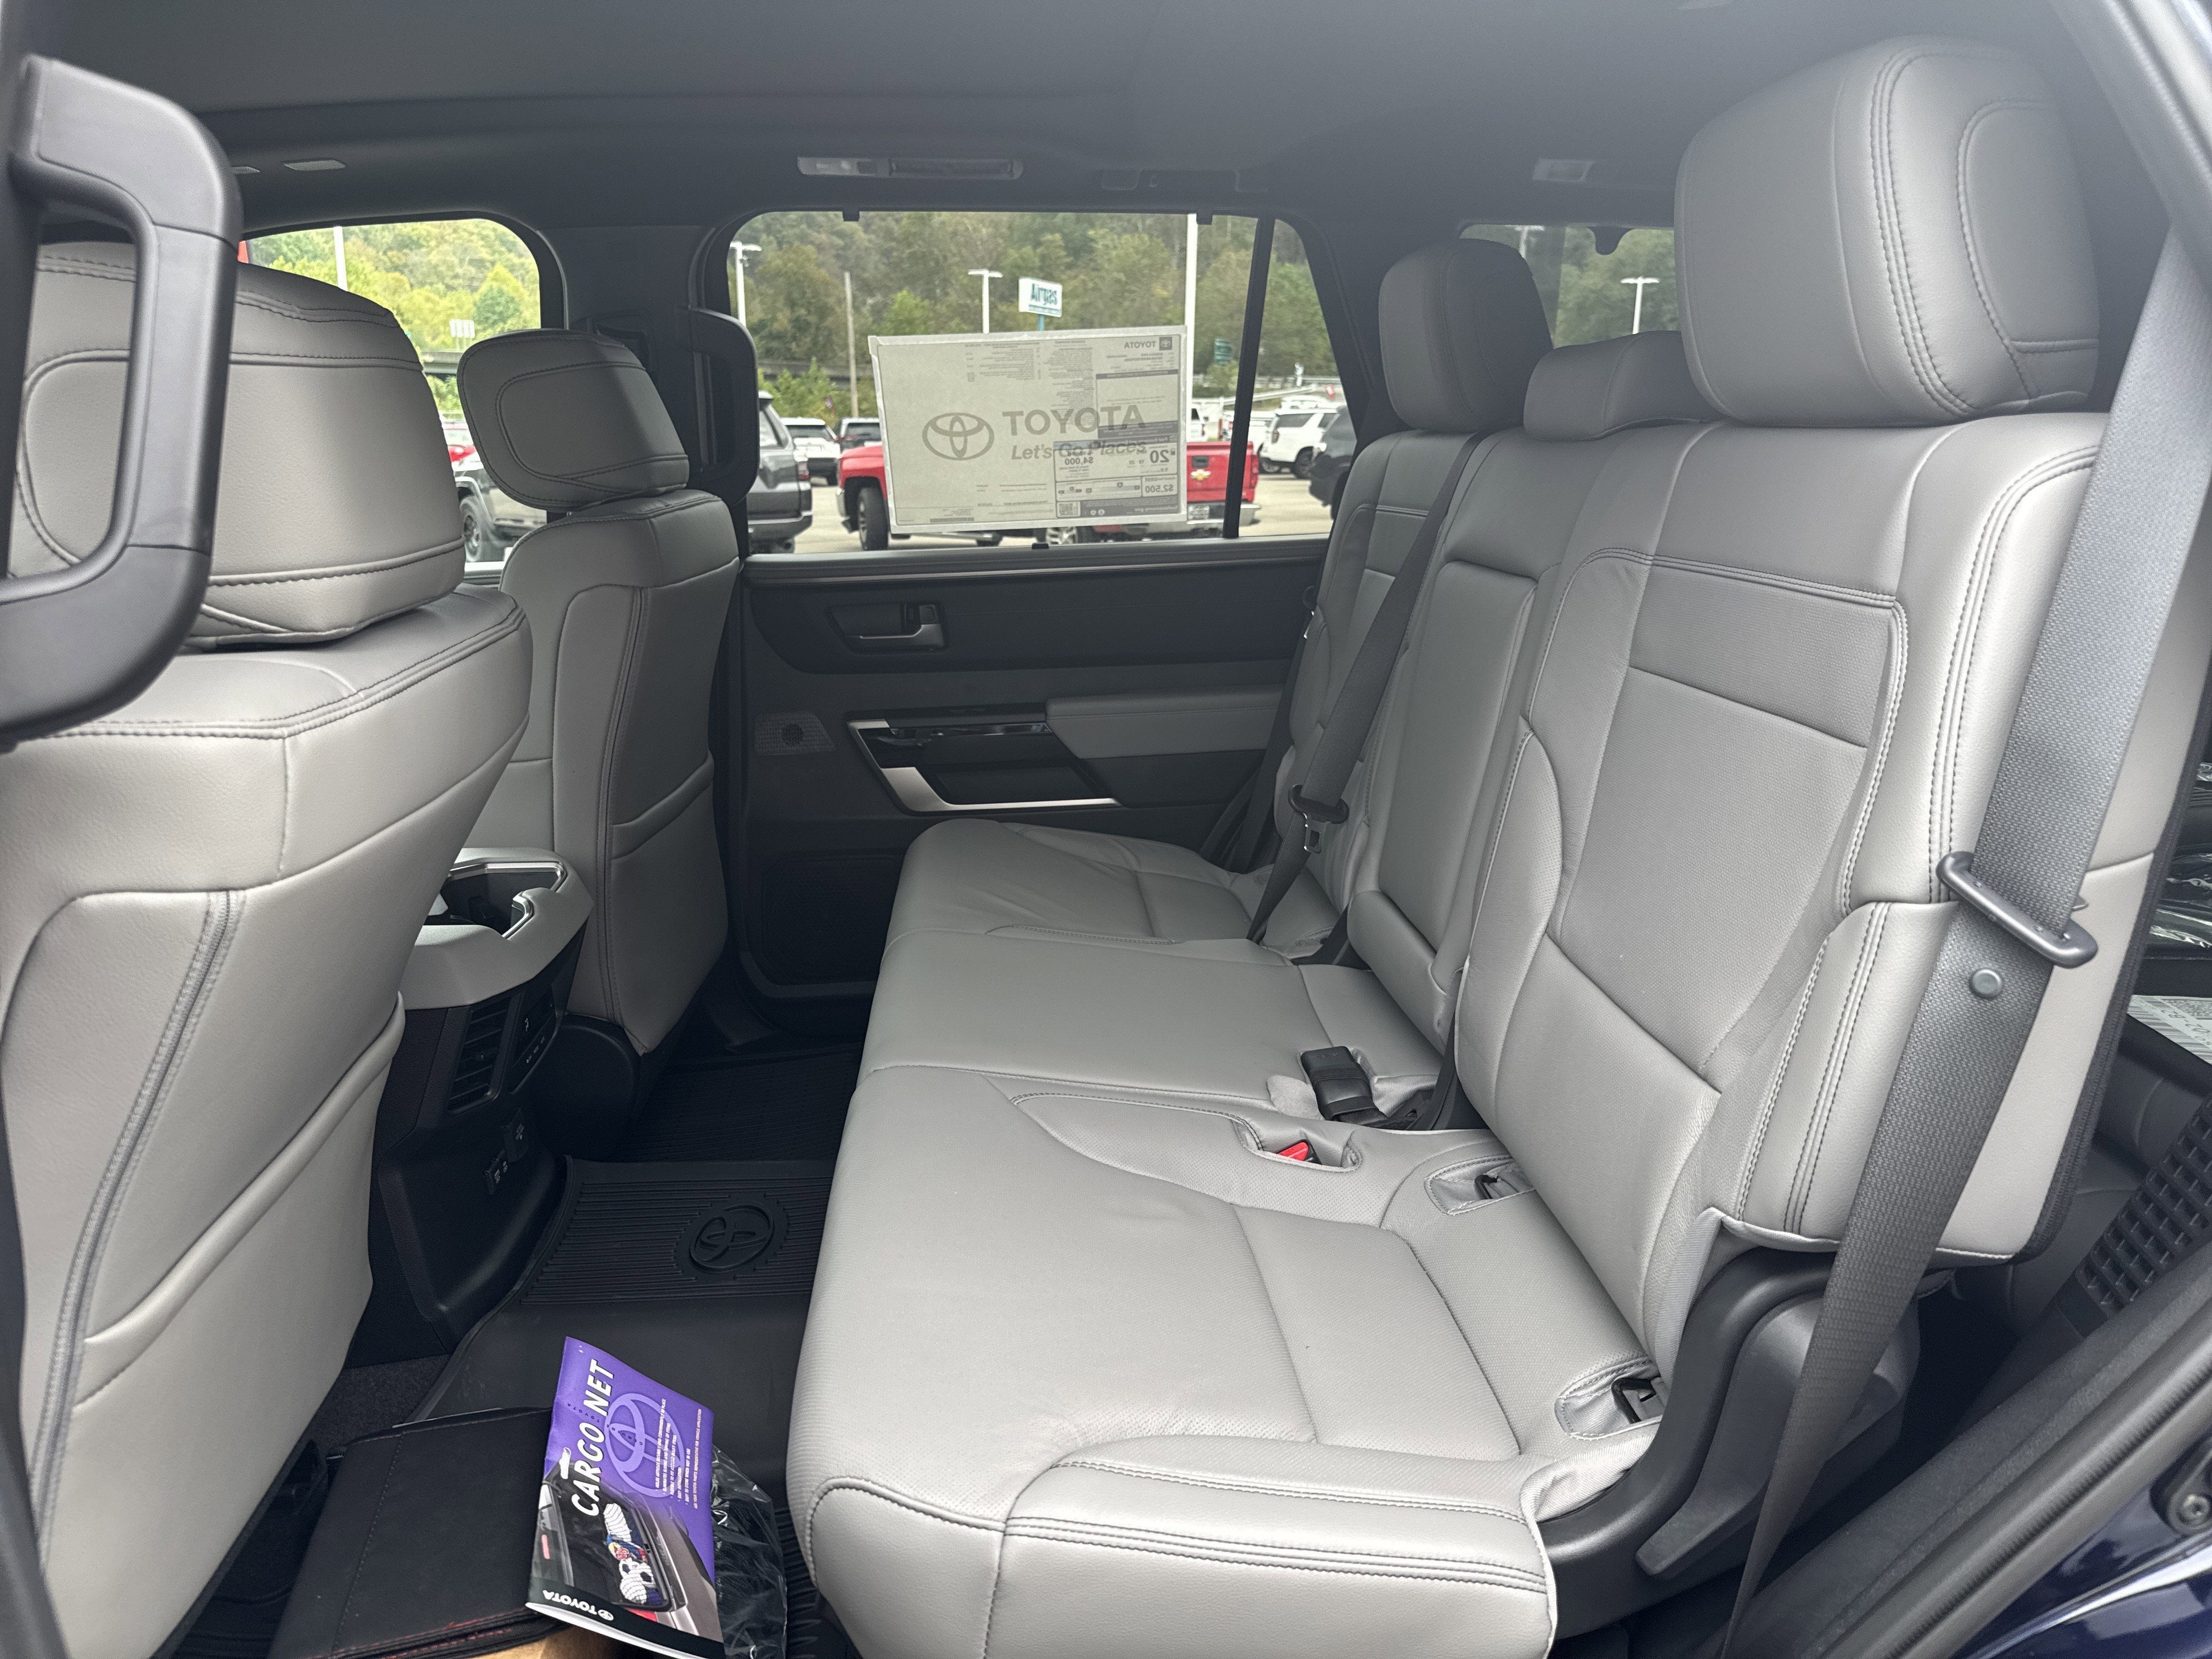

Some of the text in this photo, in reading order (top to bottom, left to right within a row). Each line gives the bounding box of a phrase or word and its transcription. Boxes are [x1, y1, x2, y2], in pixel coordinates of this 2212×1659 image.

[1031, 283, 1057, 306] Airgas
[1002, 404, 1145, 436] TOYOTA
[1011, 444, 1053, 460] Let's
[1091, 437, 1147, 455] Places
[571, 1358, 616, 1516] CARGO NET
[543, 1590, 597, 1615] TOYOTA
